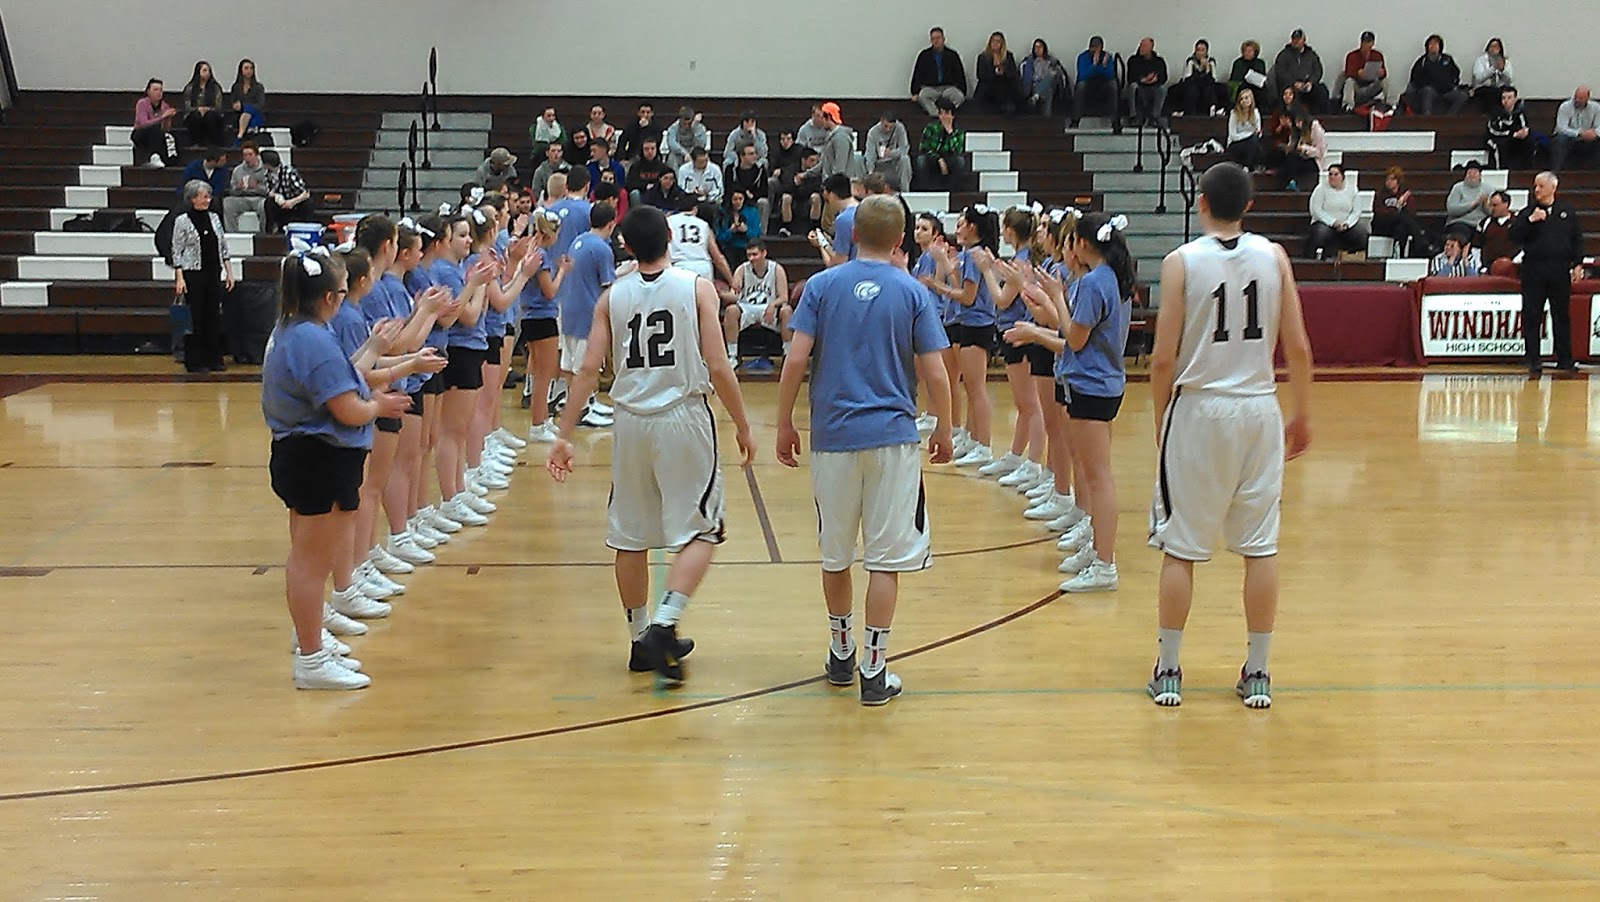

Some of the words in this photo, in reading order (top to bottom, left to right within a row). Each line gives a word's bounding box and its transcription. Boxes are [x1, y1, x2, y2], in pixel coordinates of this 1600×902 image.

[679, 223, 701, 244] 13
[1211, 279, 1263, 343] 11
[626, 309, 676, 369] 12
[1446, 343, 1475, 352] HIGH
